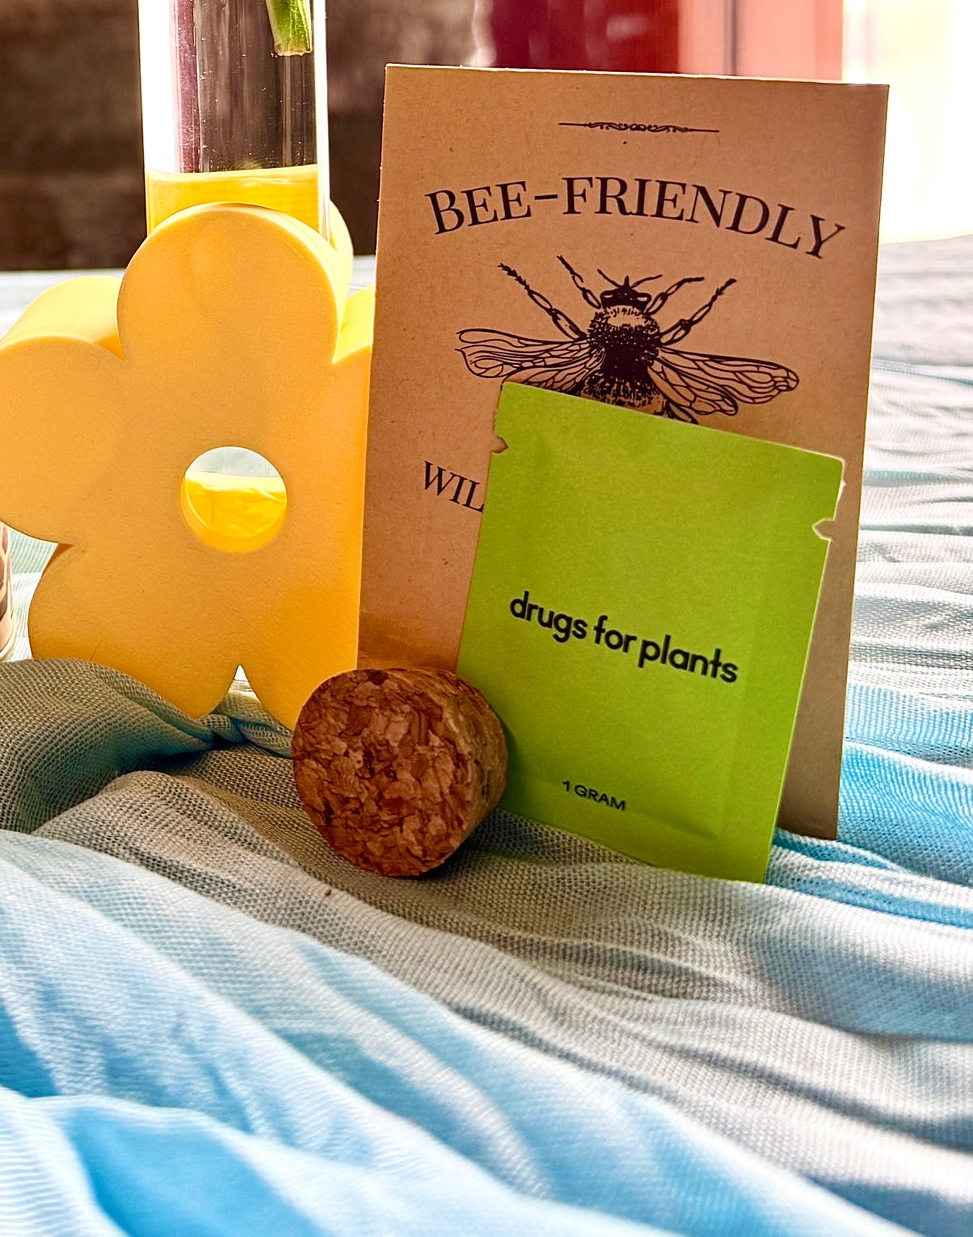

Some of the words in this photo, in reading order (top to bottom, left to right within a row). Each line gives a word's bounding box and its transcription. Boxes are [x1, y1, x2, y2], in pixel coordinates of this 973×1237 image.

[425, 176, 846, 259] BEE-FRIENDLY
[424, 460, 485, 513] WIL
[509, 591, 588, 643] drugs
[593, 615, 637, 653] for
[638, 635, 739, 683] plants
[562, 780, 571, 794] 1
[574, 784, 627, 812] GRAM
